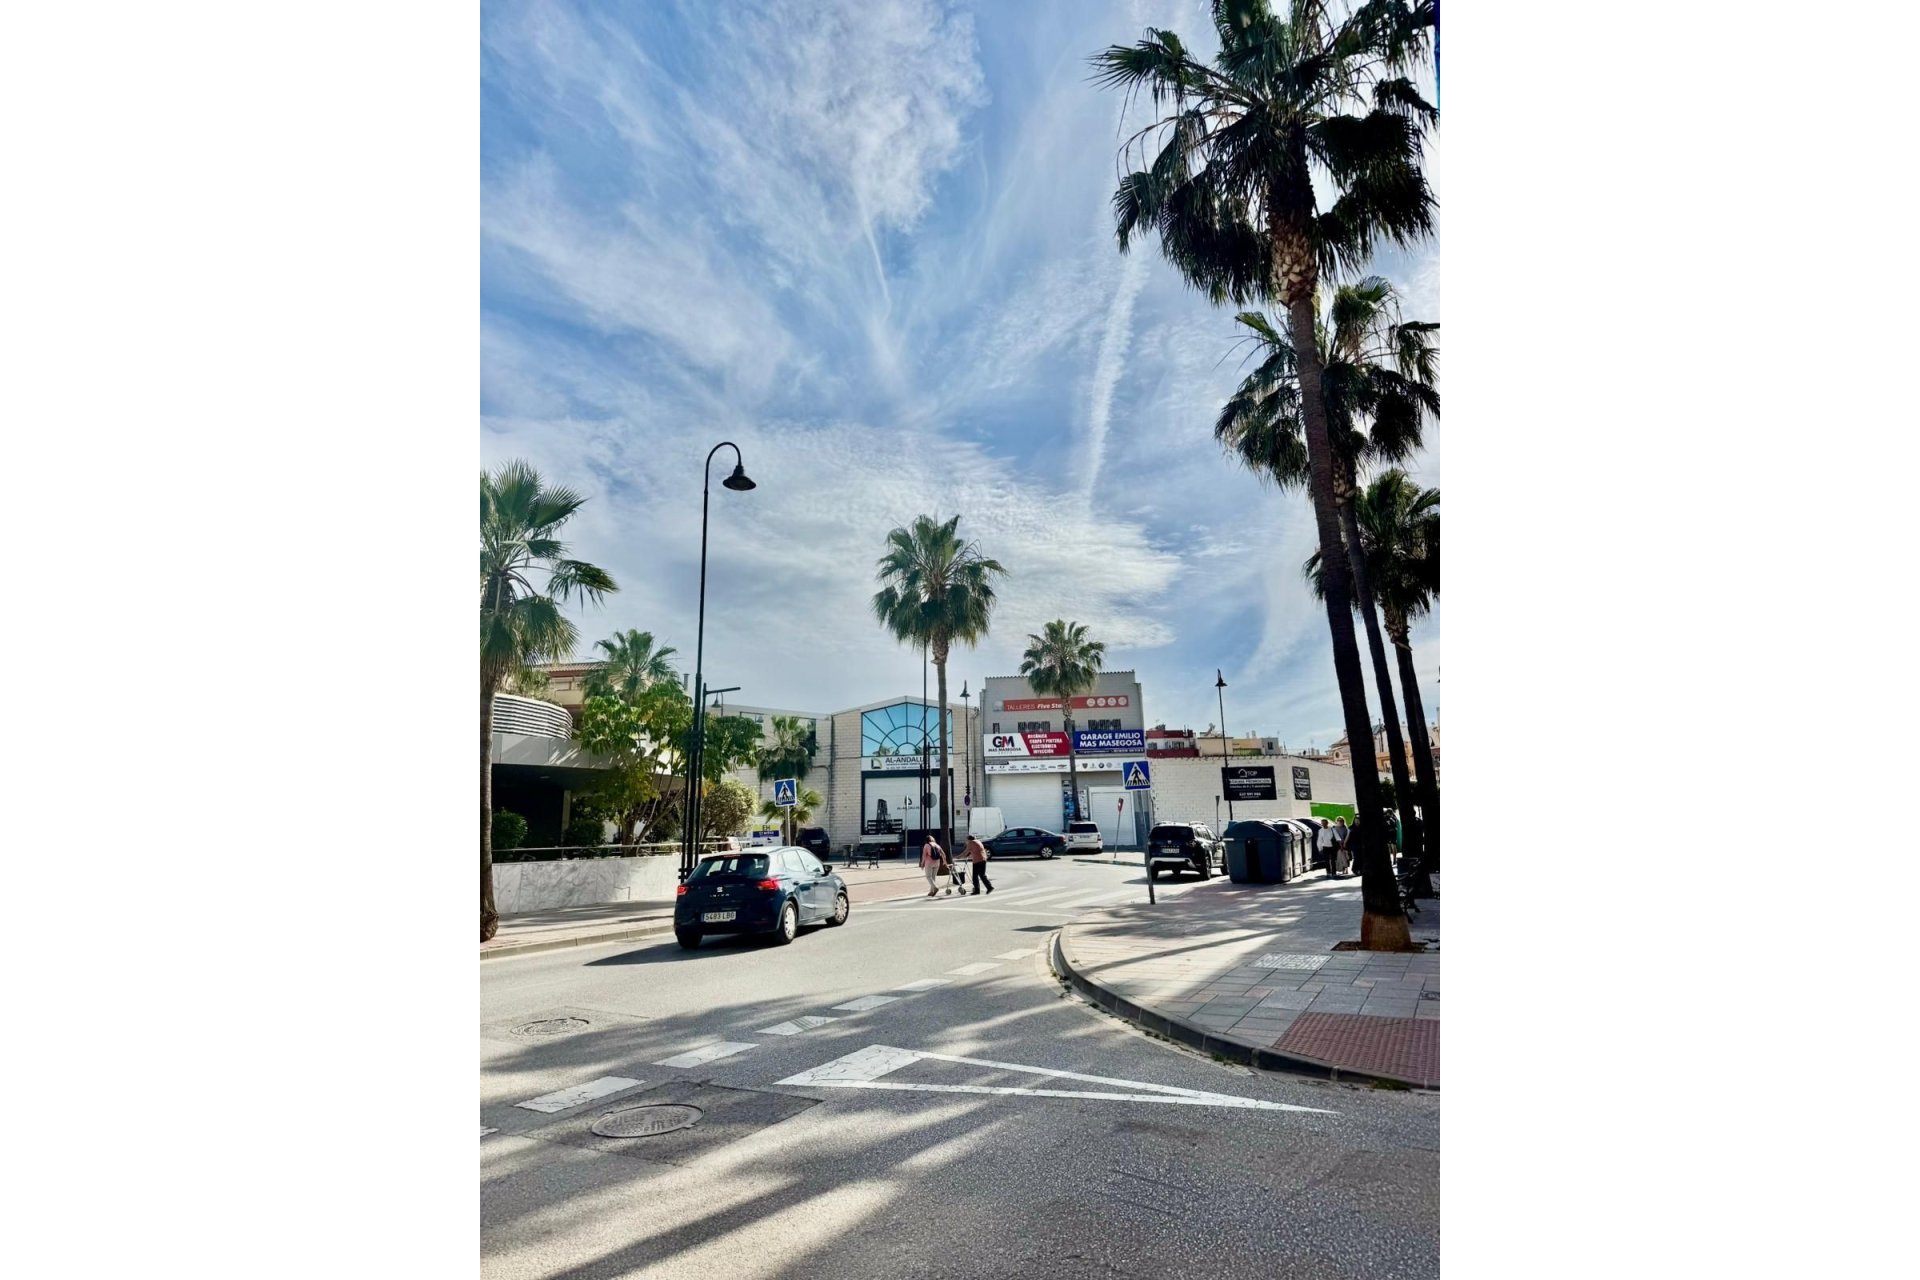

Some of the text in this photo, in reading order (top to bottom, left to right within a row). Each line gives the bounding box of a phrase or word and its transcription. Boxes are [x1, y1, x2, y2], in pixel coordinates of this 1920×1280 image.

[1080, 732, 1141, 741] GARAGE EMILIO
[992, 735, 1015, 748] GM
[1079, 739, 1143, 748] MAS MASEGOSA
